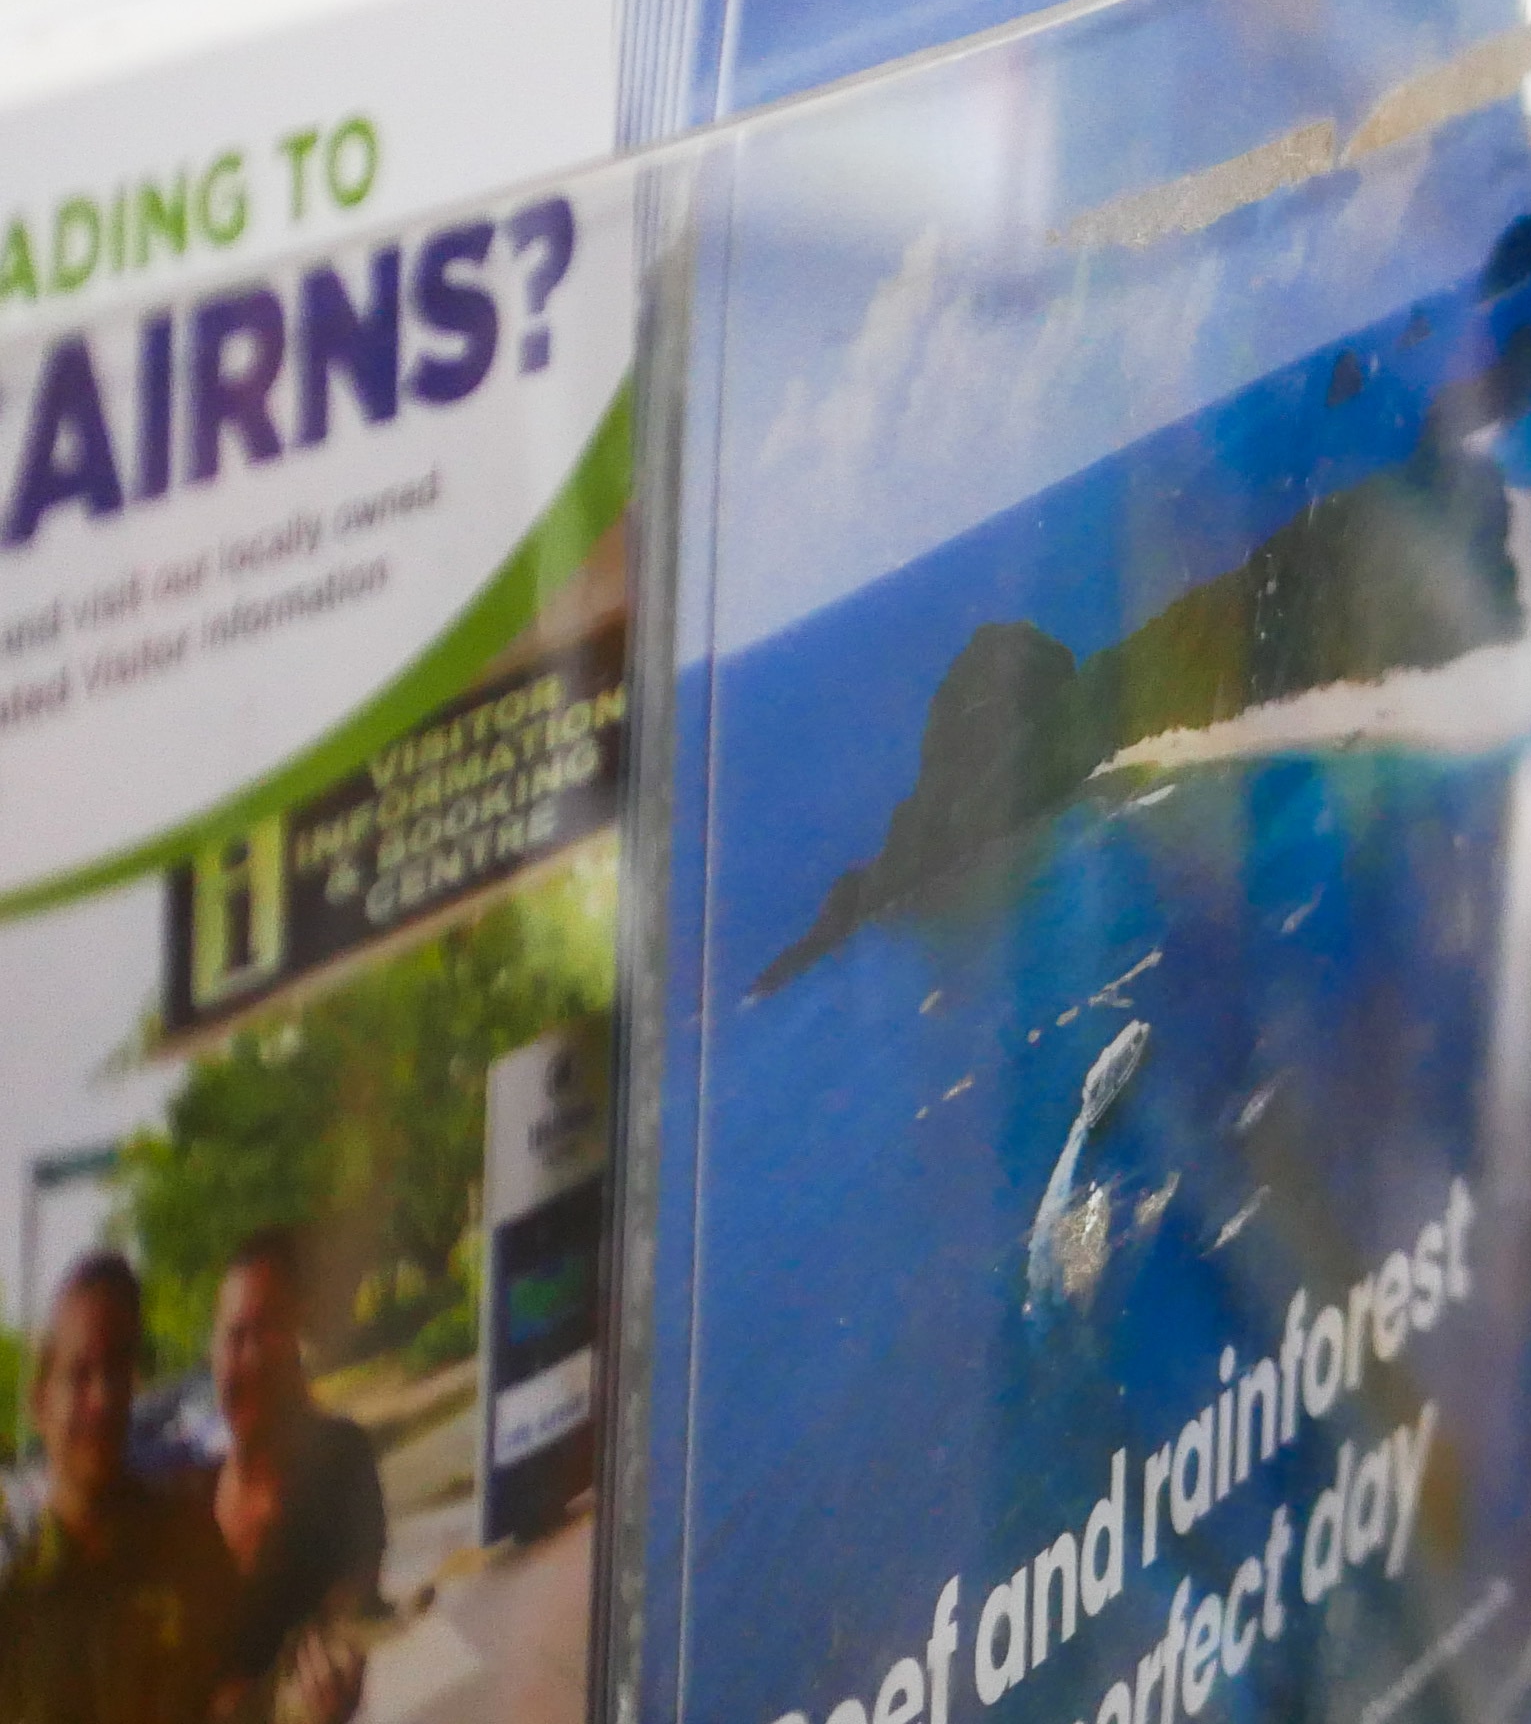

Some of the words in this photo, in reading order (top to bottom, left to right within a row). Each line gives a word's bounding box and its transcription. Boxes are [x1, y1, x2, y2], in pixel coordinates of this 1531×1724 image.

[0, 148, 246, 304] ADING
[273, 109, 381, 221] TO
[0, 195, 576, 550] AIRNS?
[218, 508, 324, 576] locally
[334, 460, 440, 536] owned
[295, 680, 628, 872] INFORMATION
[368, 672, 566, 791] VISITOR
[375, 735, 601, 878] BOOKING
[363, 793, 560, 926] CENTRE
[974, 1448, 1127, 1707] and
[1141, 1174, 1477, 1569] rainforest
[1302, 1399, 1440, 1605] day
